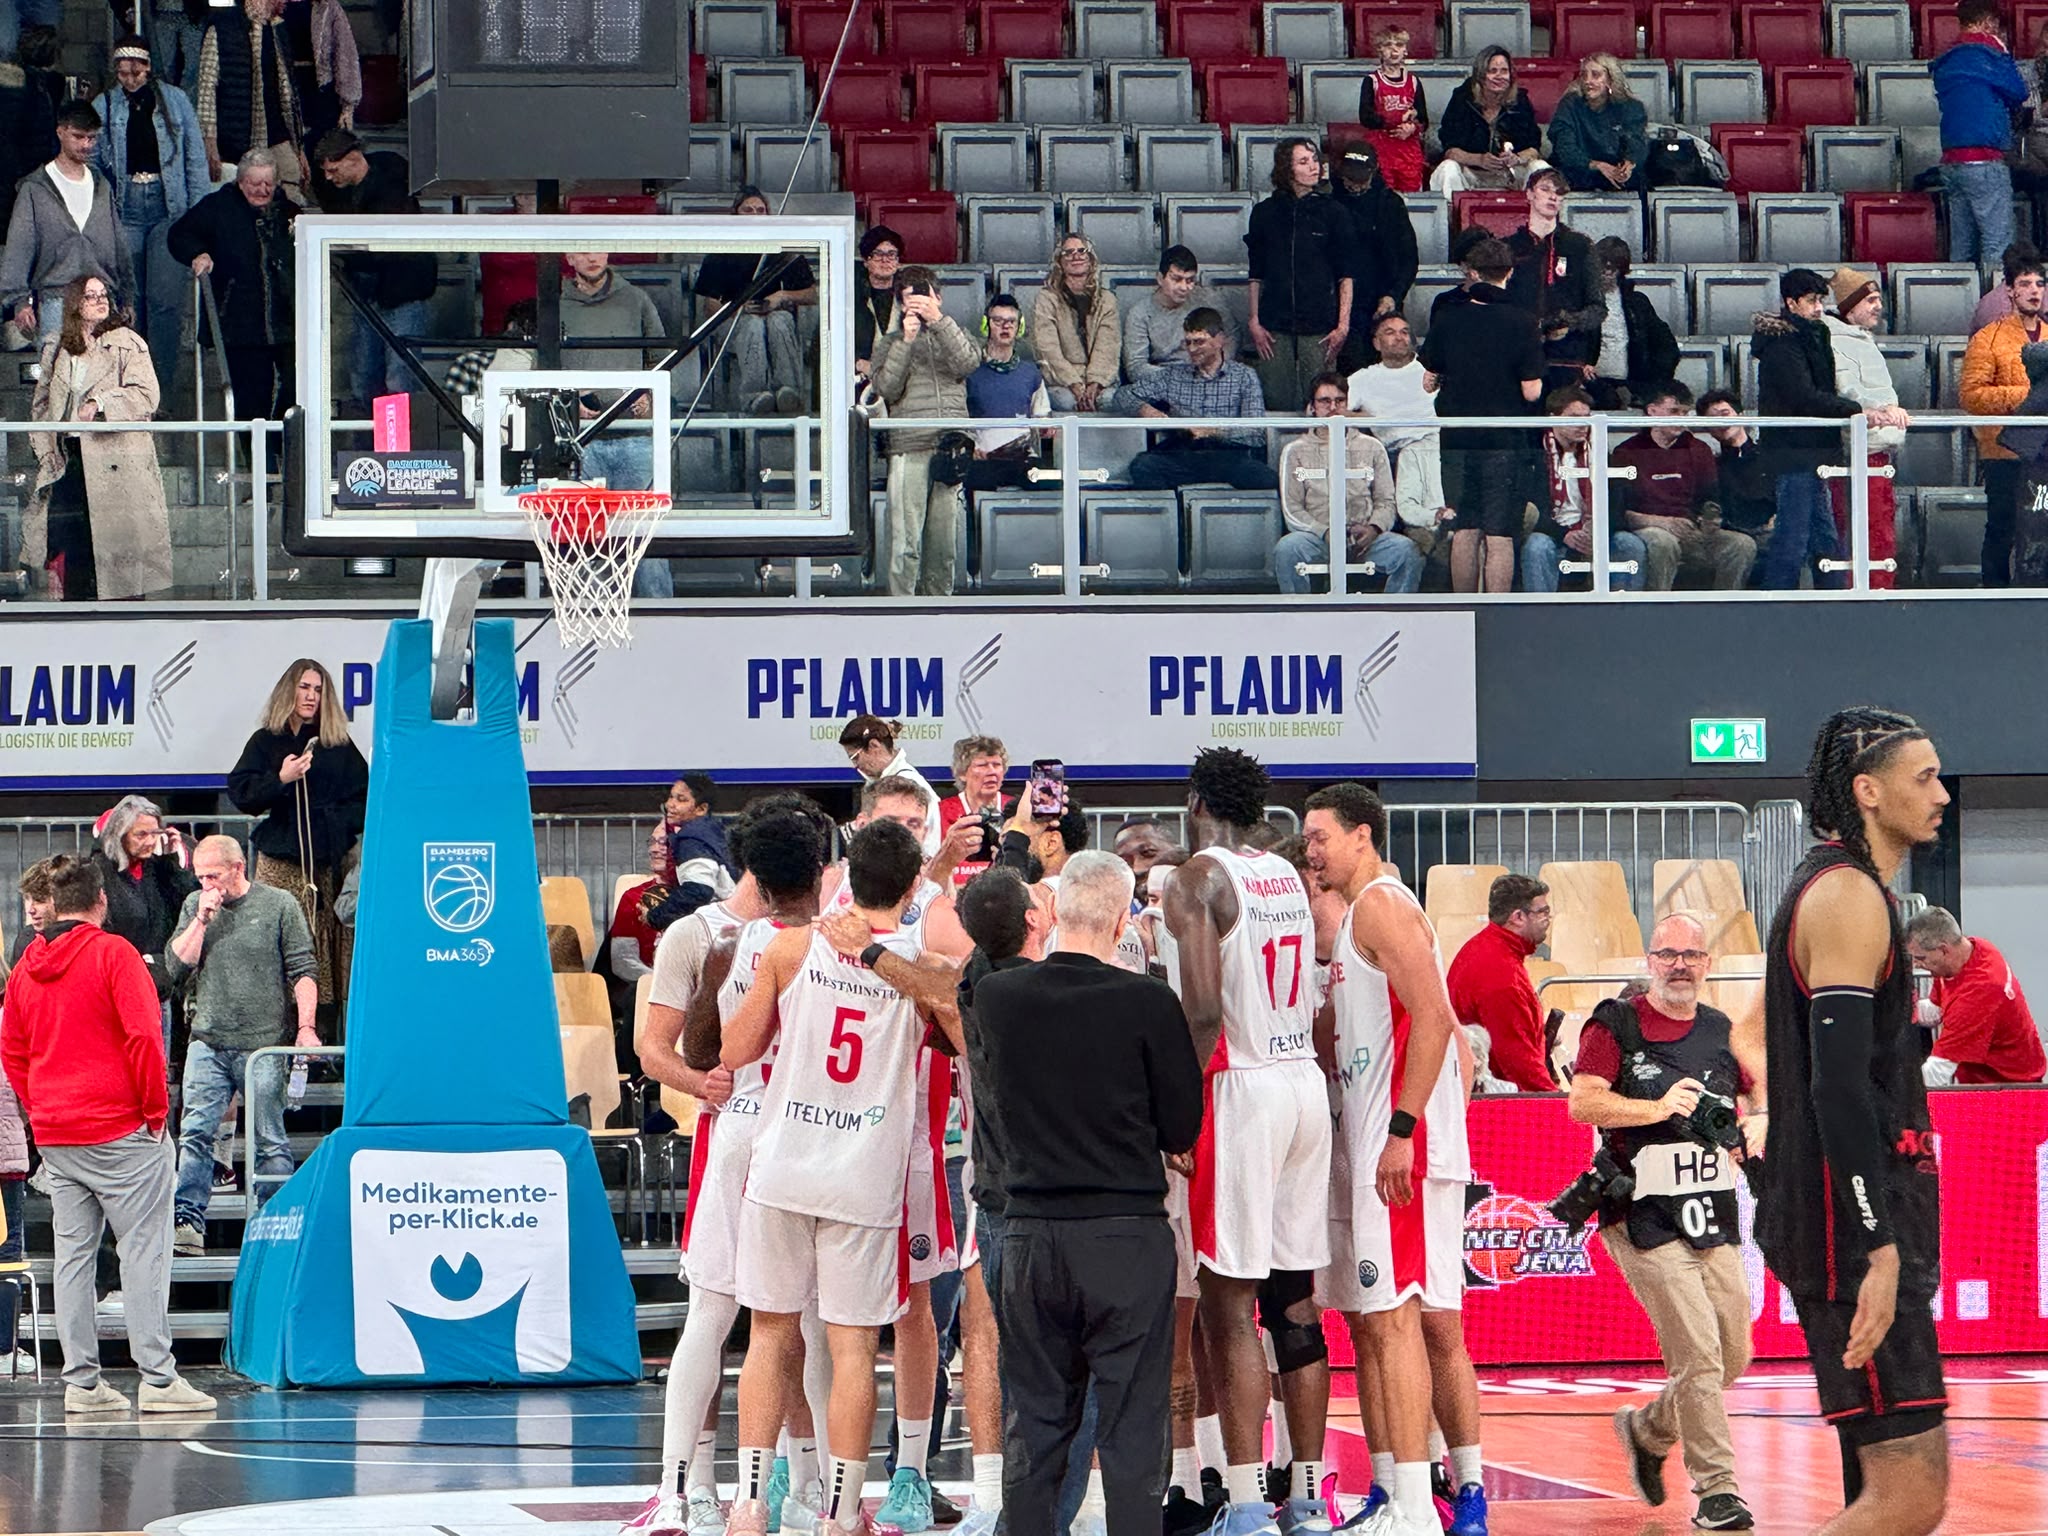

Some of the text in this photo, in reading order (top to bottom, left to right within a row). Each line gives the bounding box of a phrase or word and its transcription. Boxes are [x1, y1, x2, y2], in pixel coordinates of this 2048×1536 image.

[387, 460, 451, 469] BASKETBALL
[387, 469, 458, 480] CHAMPIONS
[387, 480, 435, 490] LEAGUE
[748, 658, 944, 718] PFLAUM
[1150, 655, 1343, 715] PFLAUM
[0, 732, 134, 748] LOGISTIK DIE BEWEGT
[810, 724, 943, 740] LOGIS EWEGT
[1212, 721, 1344, 737] LOGISTIK DIE BEWEGT
[430, 848, 488, 856] BAMBERG
[426, 948, 485, 962] BMA365
[1262, 934, 1303, 1010] 17
[809, 969, 905, 1000] WESTMINSTE
[826, 1006, 866, 1084] 5
[786, 1101, 862, 1131] ITELYUM
[1674, 1150, 1719, 1186] HB
[362, 1182, 558, 1204] Medikamente-
[1852, 1175, 1876, 1220] CRAFT
[389, 1208, 539, 1236] per-Klick.de
[1512, 1253, 1587, 1273] JENA
